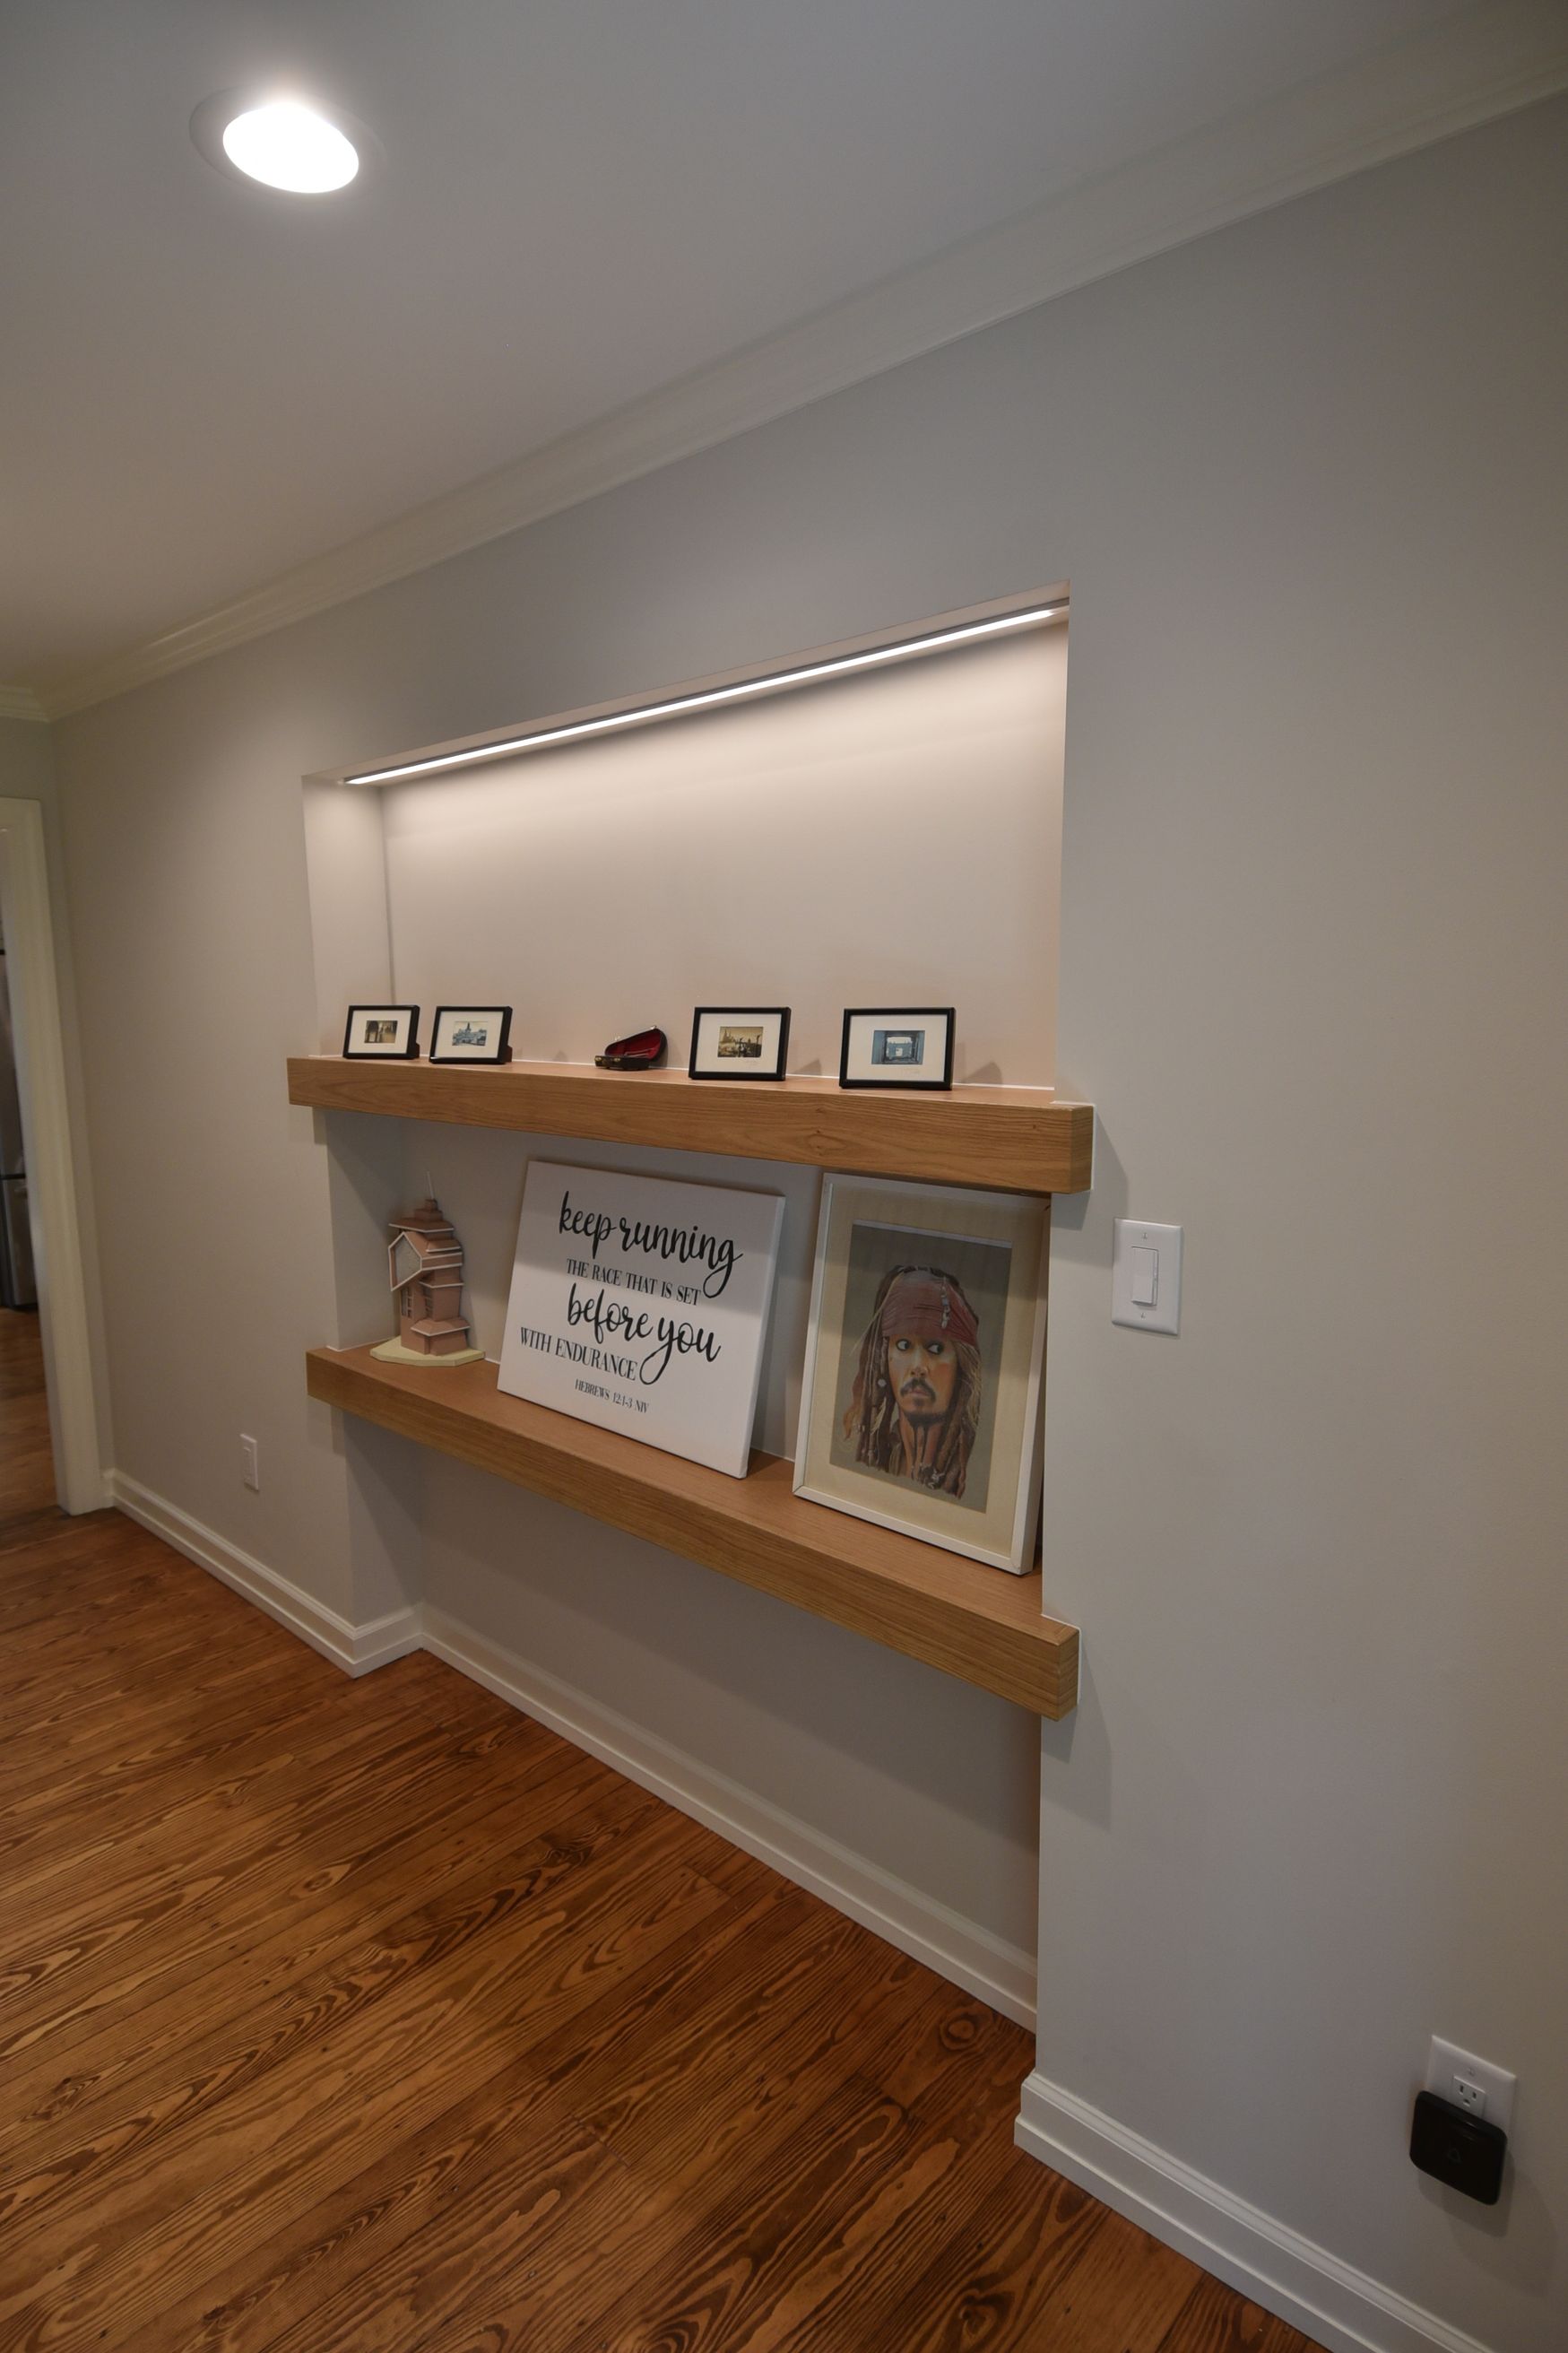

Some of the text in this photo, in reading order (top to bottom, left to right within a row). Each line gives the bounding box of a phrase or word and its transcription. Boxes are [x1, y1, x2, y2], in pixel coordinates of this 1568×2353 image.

[559, 1190, 743, 1298] keep running
[567, 1258, 701, 1306] THE RACE THAT IS SET
[520, 1327, 637, 1381] WITH ENDURANCE
[567, 1283, 721, 1385] before you
[576, 1379, 610, 1400] HEBREWS
[635, 1400, 650, 1413] NIV
